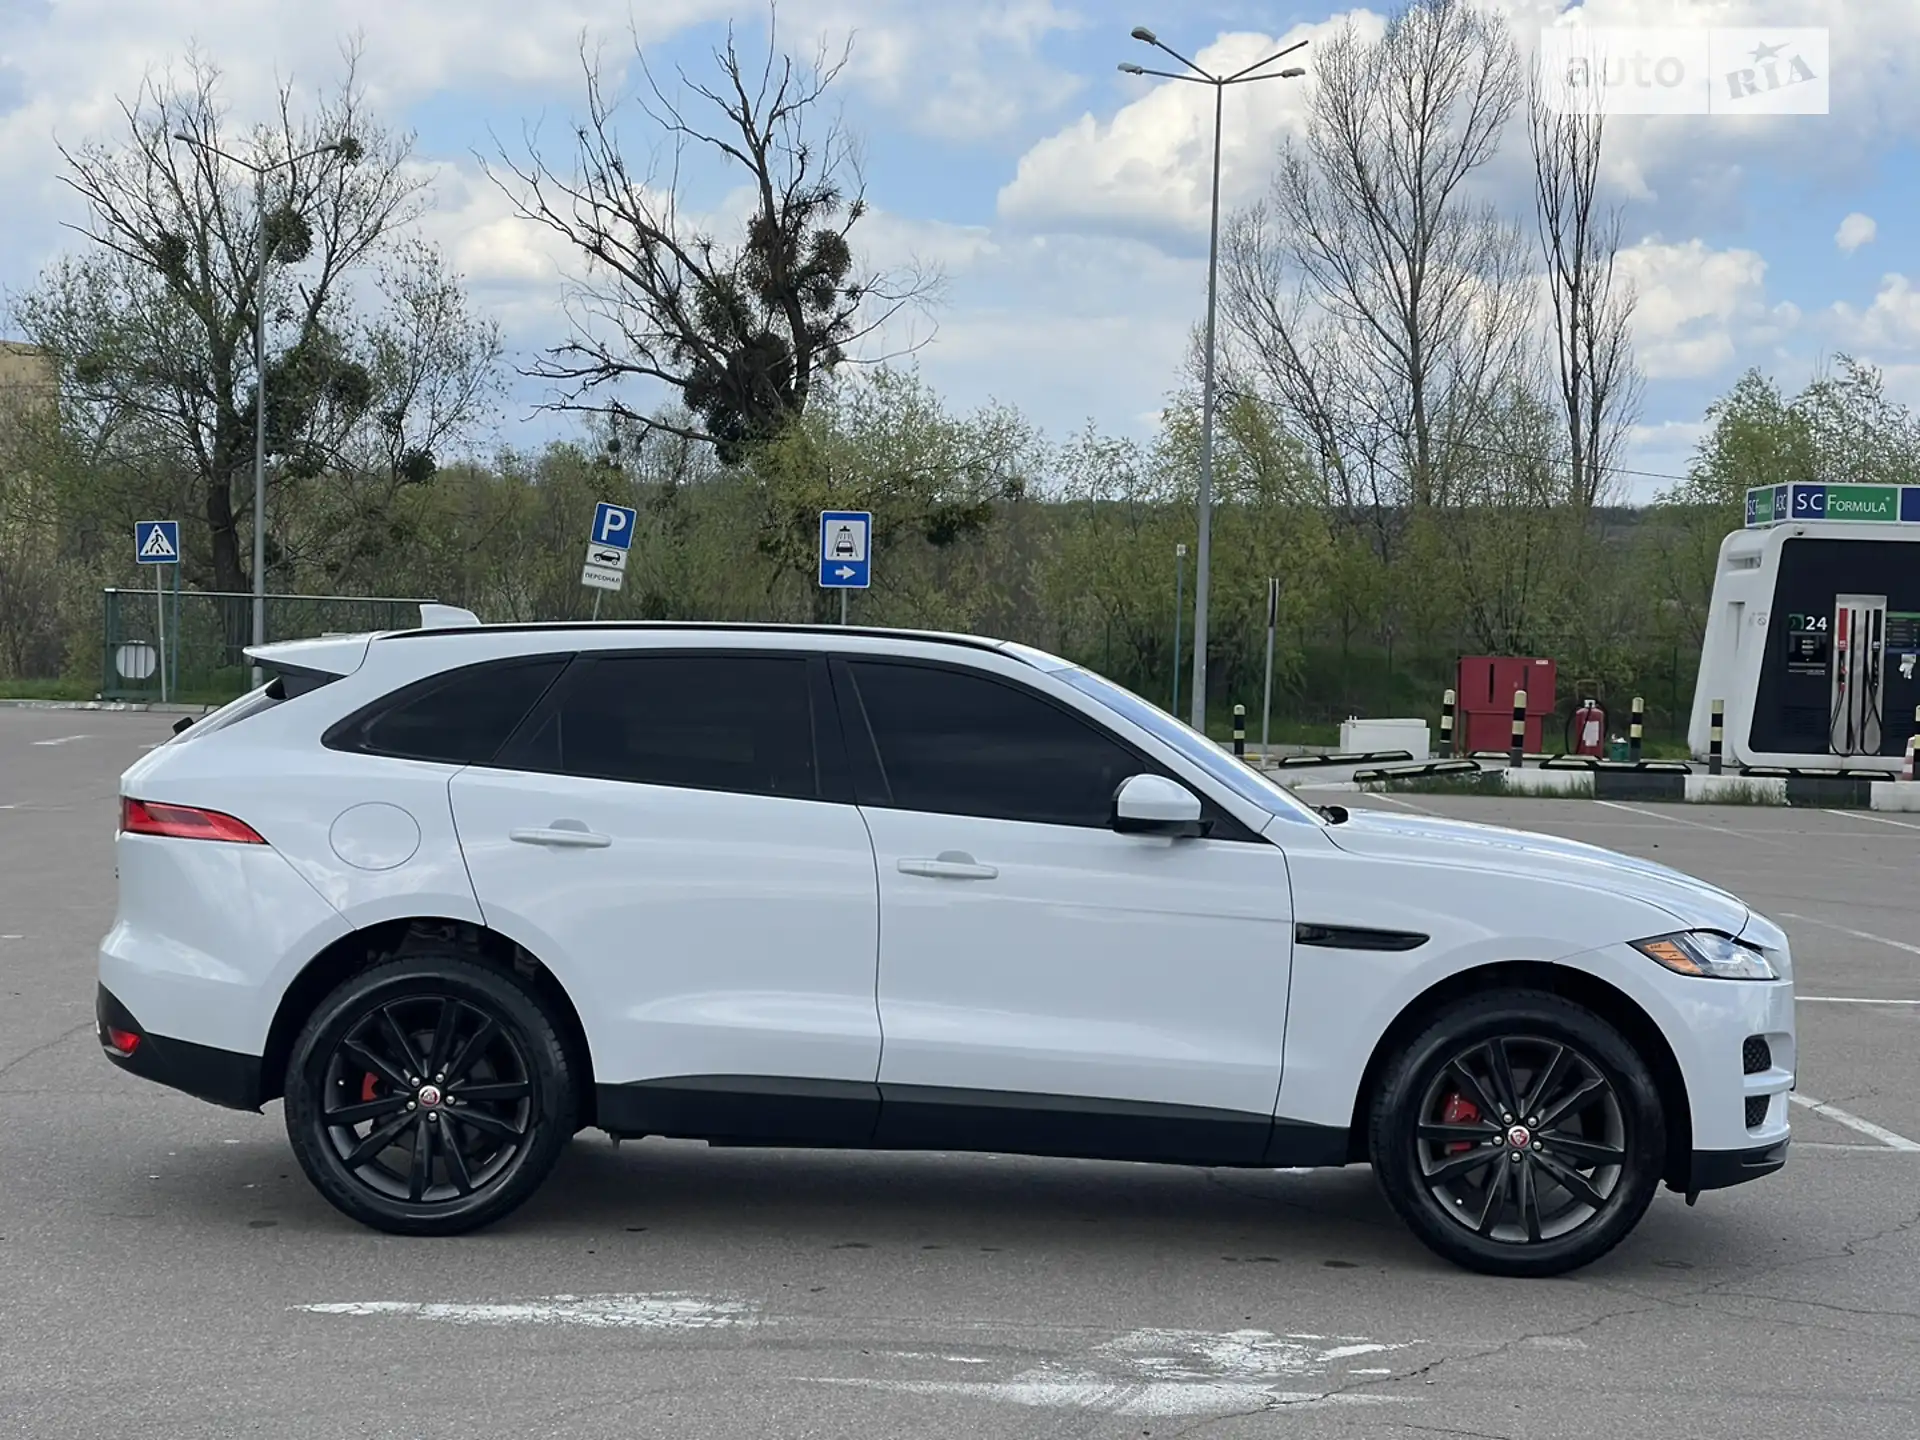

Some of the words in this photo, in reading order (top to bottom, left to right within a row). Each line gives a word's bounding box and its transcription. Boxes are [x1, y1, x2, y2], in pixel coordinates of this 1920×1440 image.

[1796, 493, 1824, 511] SC
[601, 507, 627, 541] P
[1805, 616, 1828, 631] 24
